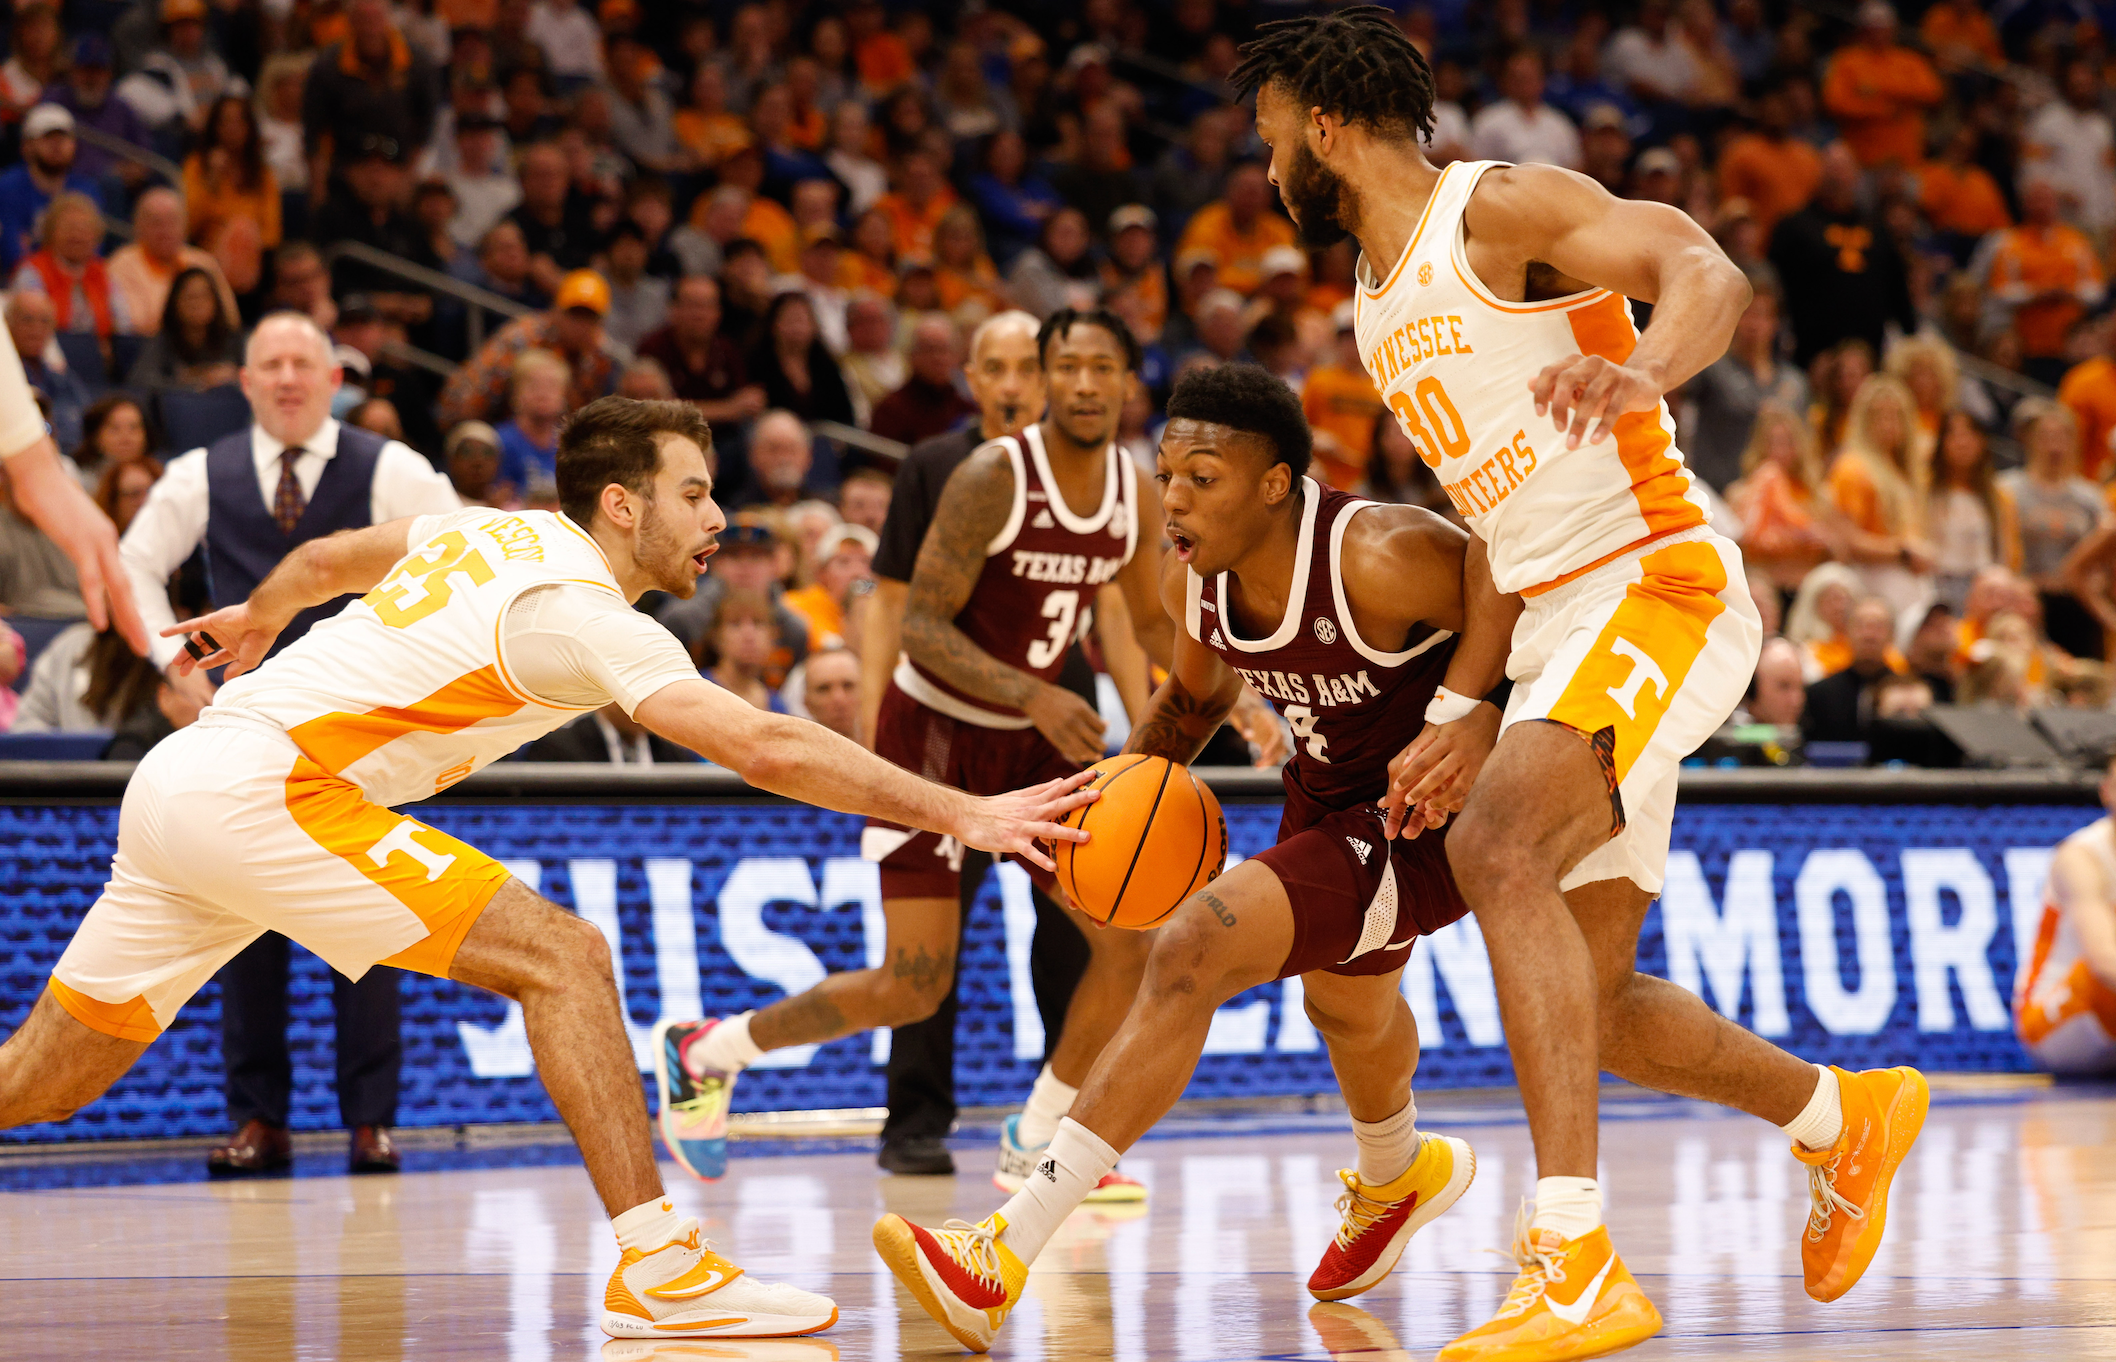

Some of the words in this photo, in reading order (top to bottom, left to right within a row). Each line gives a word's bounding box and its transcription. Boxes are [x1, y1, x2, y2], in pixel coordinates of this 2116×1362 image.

[1417, 262, 1434, 286] SEC
[1390, 376, 1471, 468] 30
[360, 531, 496, 629] 25
[1012, 550, 1087, 584] TEXAS
[1027, 590, 1079, 669] 3
[1316, 619, 1336, 642] SEC
[1233, 667, 1310, 704] EXAS
[1312, 670, 1381, 706] A&M
[1606, 635, 1669, 721] T
[1284, 704, 1331, 764] 4
[365, 819, 457, 882] T
[1346, 835, 1367, 866] adidas
